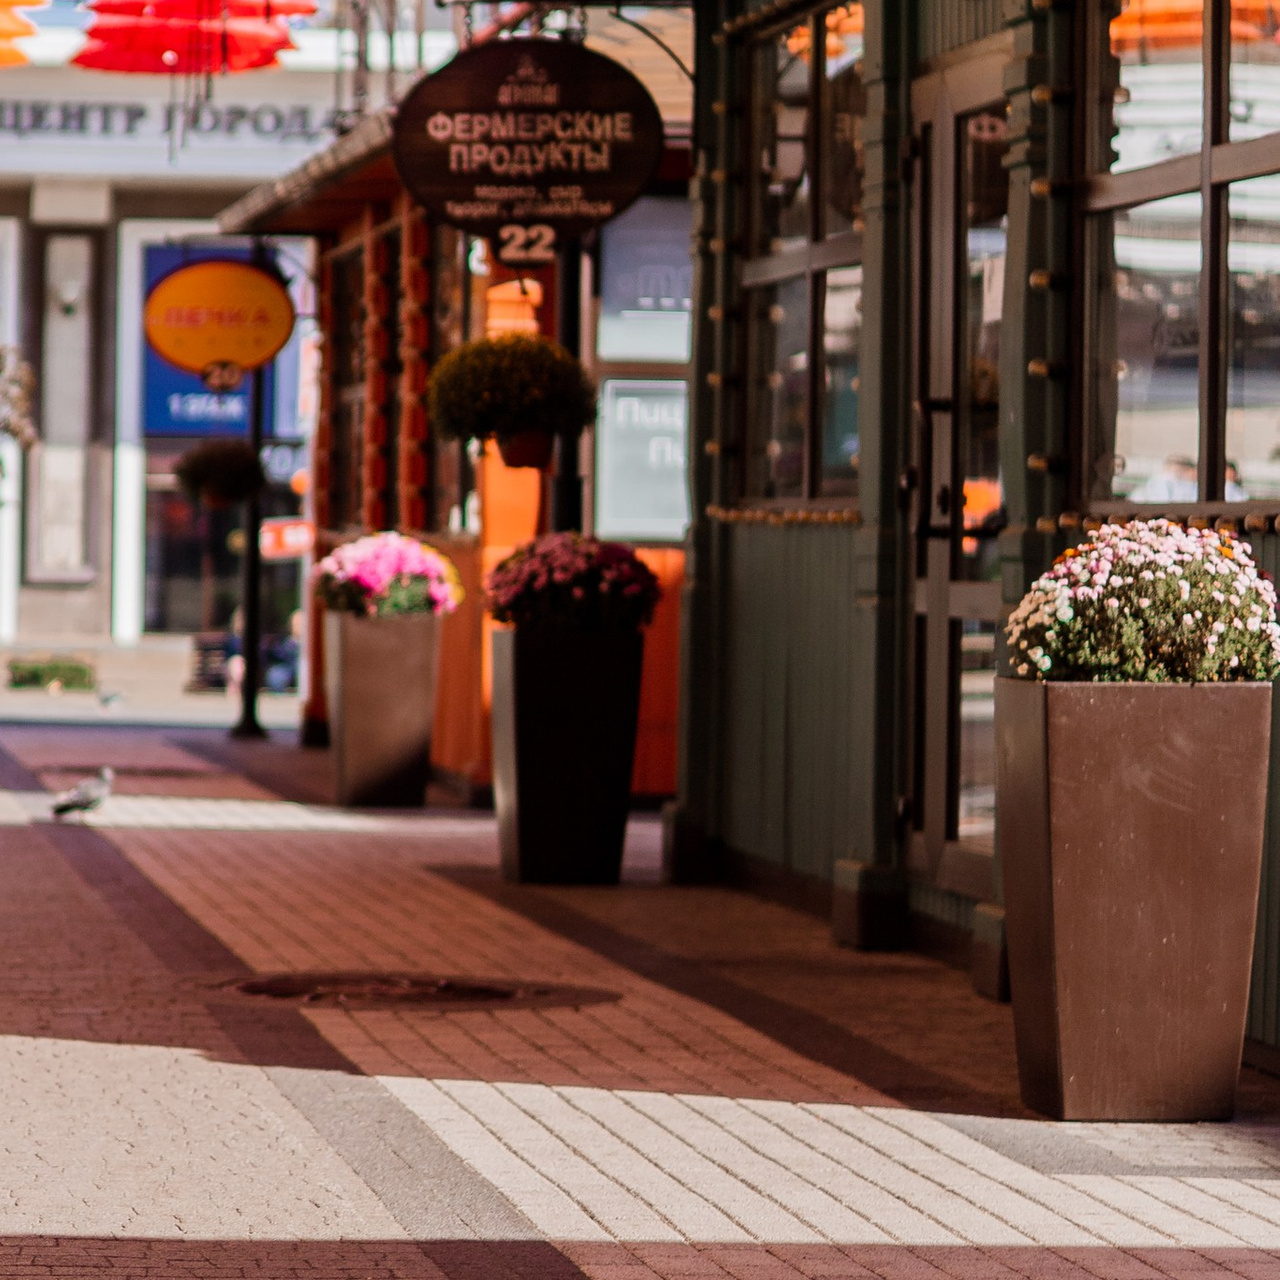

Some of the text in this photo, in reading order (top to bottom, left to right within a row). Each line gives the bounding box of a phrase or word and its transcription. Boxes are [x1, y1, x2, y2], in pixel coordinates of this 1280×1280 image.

[426, 111, 633, 142] ФЕРМЕРСКИЕ
[449, 143, 610, 178] ПРОДУКТЫ
[498, 224, 556, 261] 22
